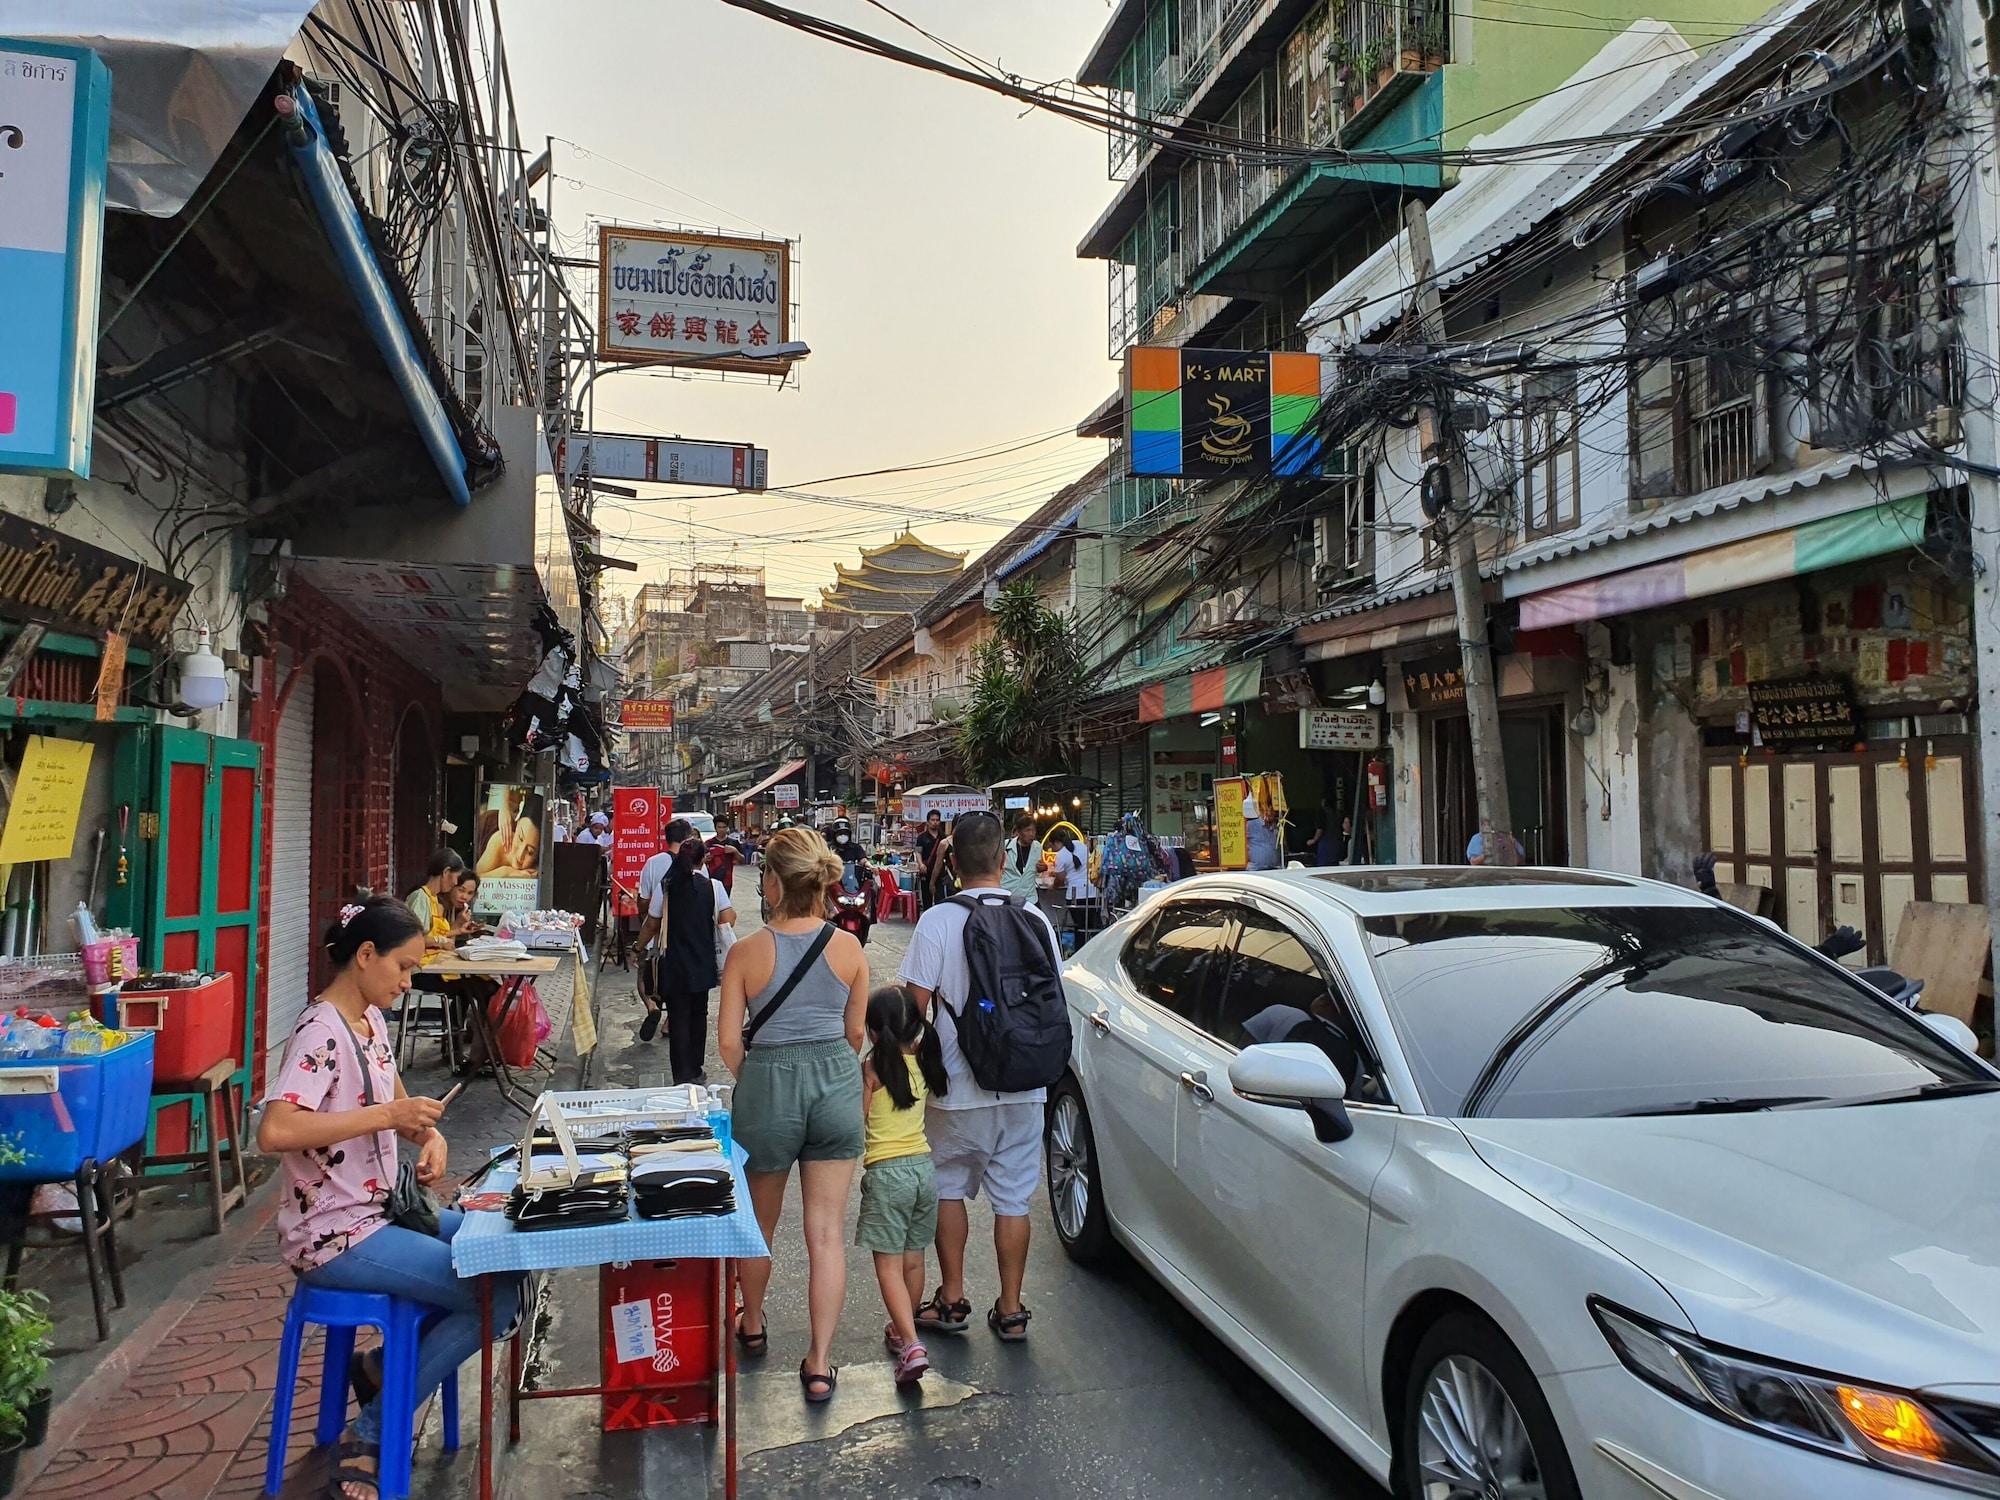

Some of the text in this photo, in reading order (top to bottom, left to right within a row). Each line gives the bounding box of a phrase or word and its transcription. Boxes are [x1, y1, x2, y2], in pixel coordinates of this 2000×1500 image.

[1186, 365, 1266, 382] K's MART
[1201, 452, 1253, 464] COFFEE TOWN
[1443, 688, 1464, 699] MART
[496, 880, 536, 893] Massage
[655, 1292, 673, 1344] envy
